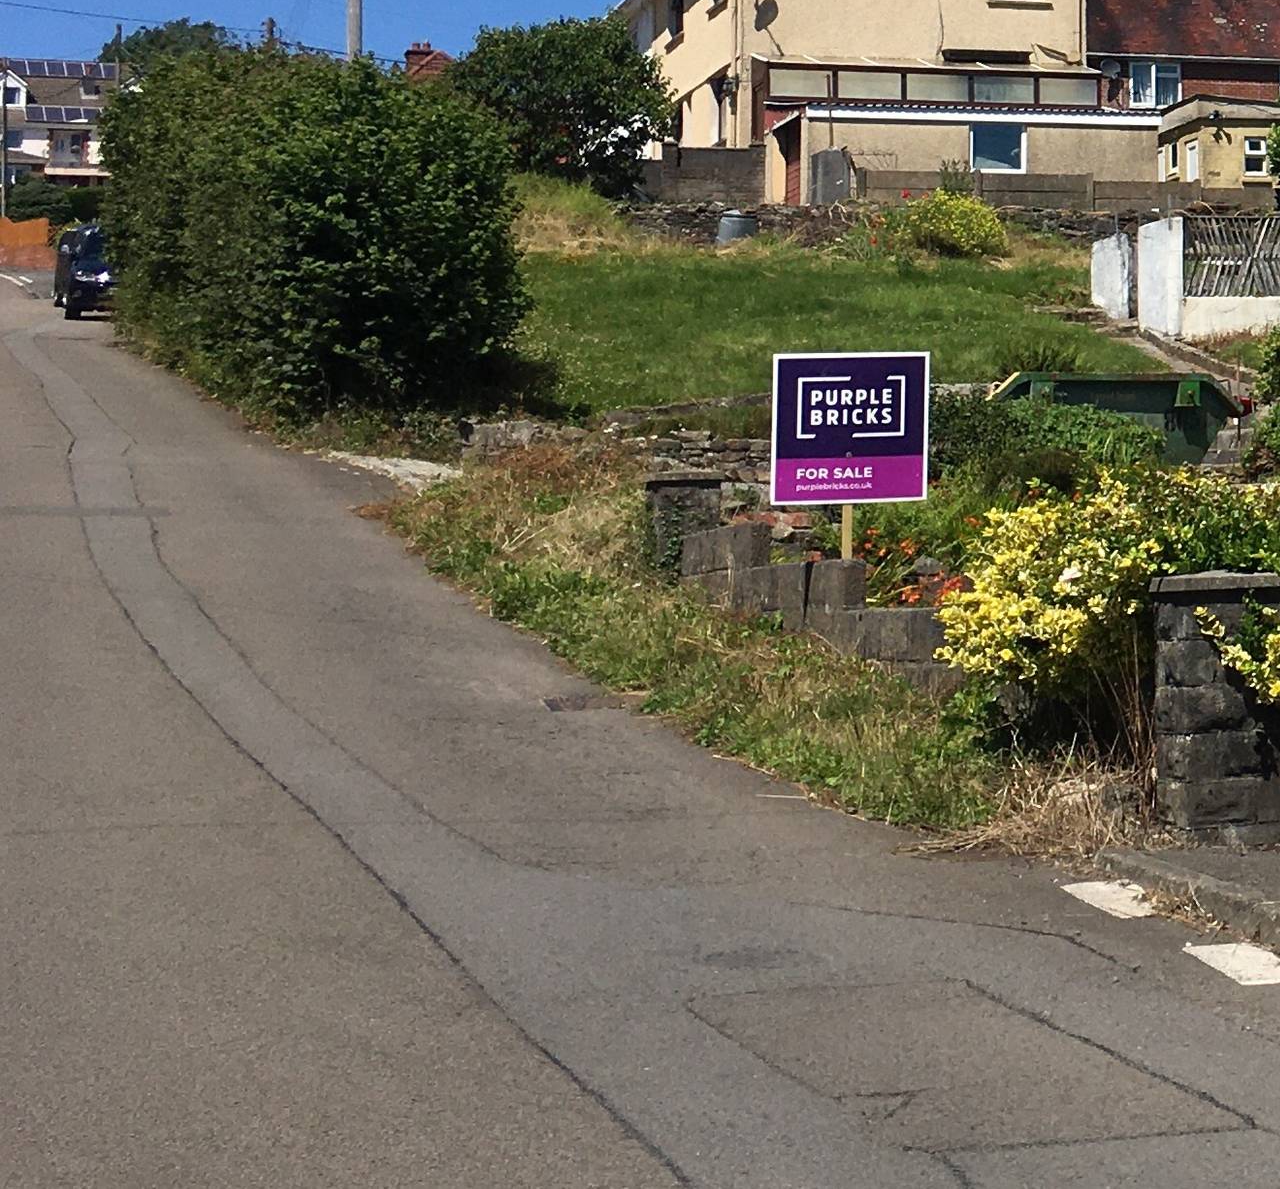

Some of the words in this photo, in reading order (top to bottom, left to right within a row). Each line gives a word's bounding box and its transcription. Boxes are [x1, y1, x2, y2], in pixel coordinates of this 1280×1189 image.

[811, 388, 893, 406] PURPLE
[810, 408, 893, 426] BRICKS
[796, 468, 829, 480] FOR
[833, 467, 873, 479] SALE
[796, 481, 873, 492] purplebricks.co.uk
